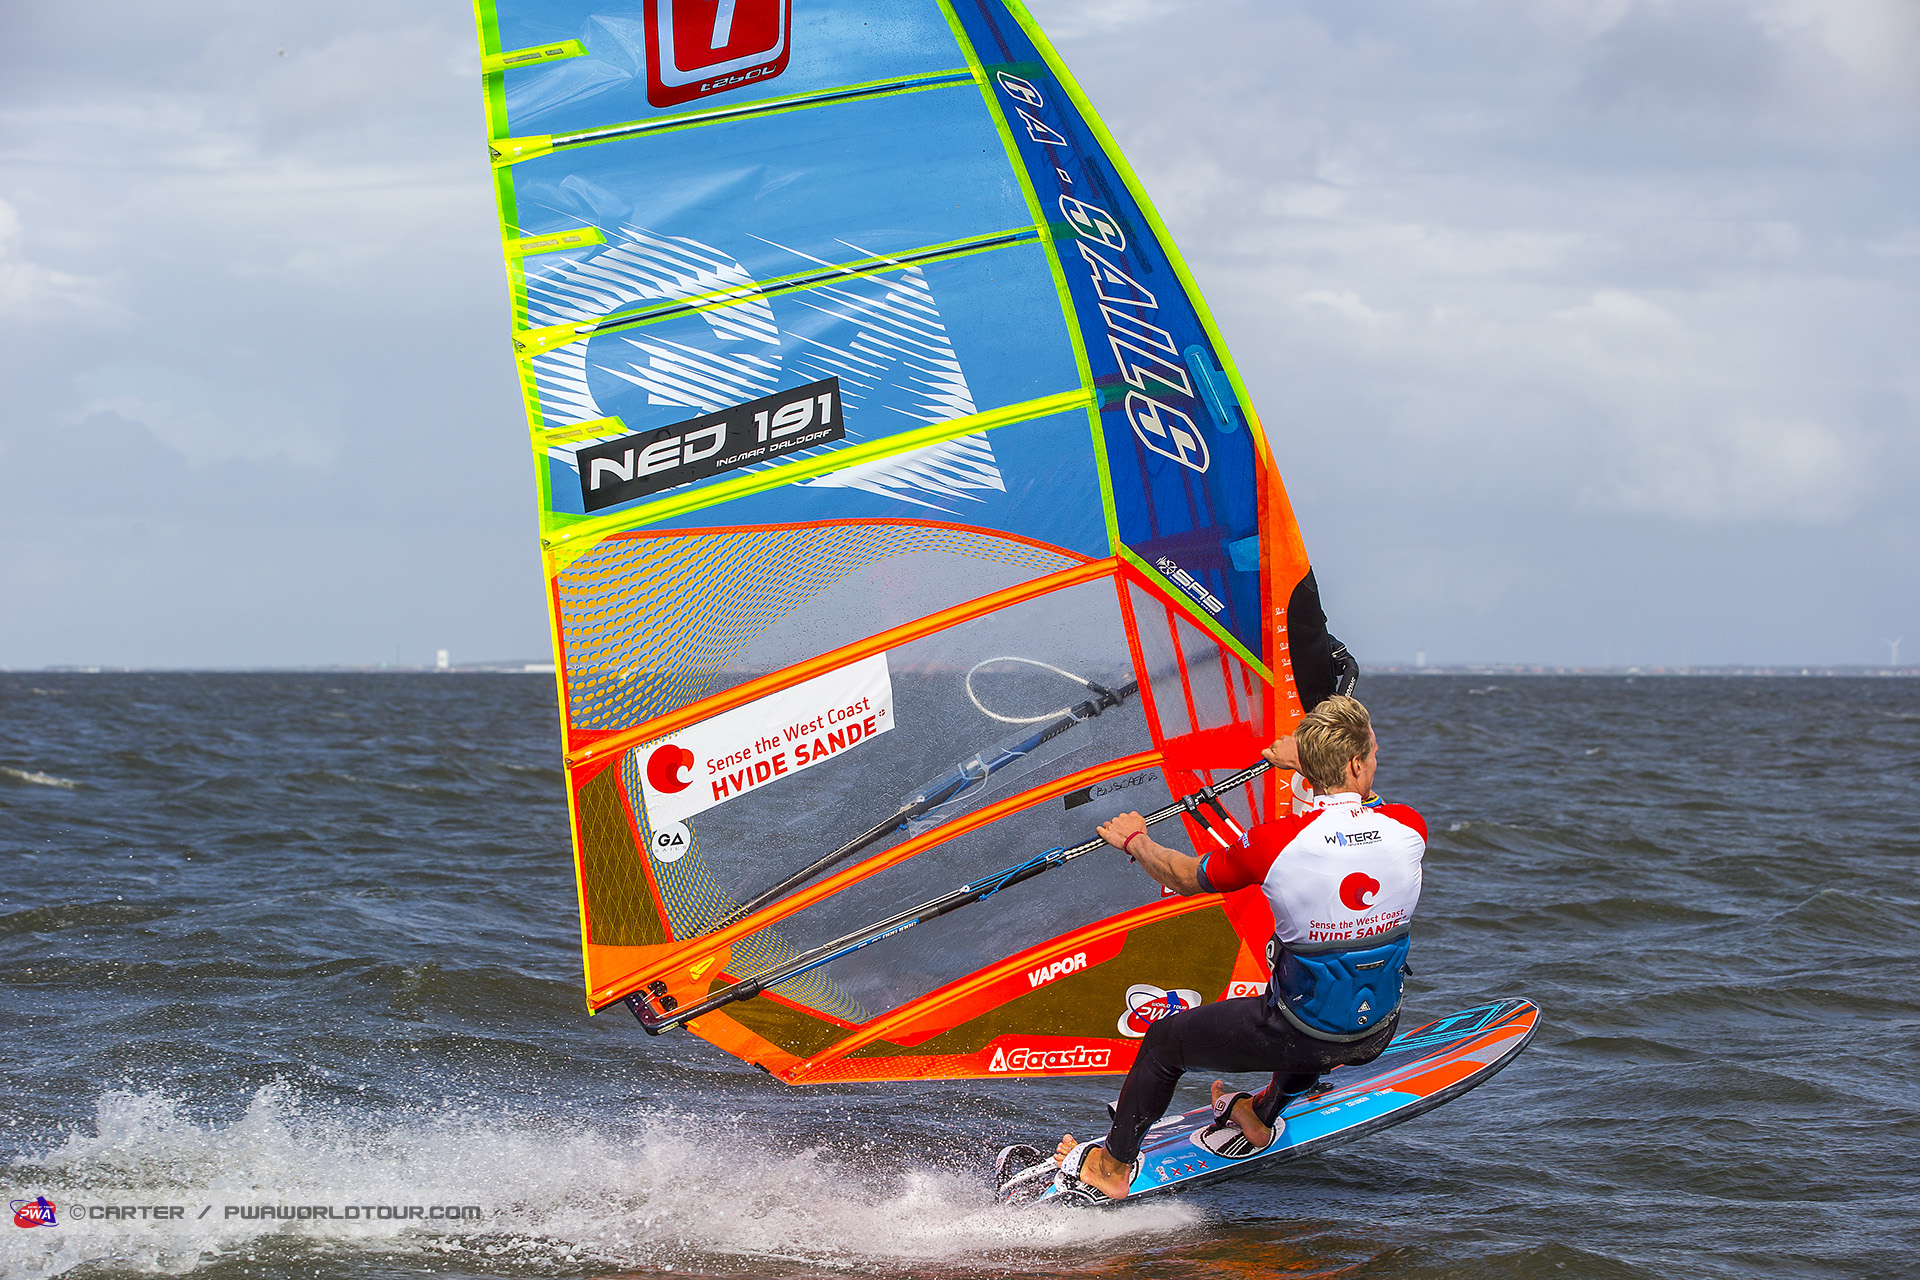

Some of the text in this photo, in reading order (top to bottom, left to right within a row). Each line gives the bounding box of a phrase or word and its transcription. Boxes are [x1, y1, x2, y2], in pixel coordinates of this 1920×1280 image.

[1058, 194, 1210, 474] SAILS
[589, 392, 833, 491] NED 191
[716, 428, 832, 468] INGMAR DALDORF
[706, 696, 871, 775] Sense the West Coast
[711, 714, 877, 802] HVIDE SANDE
[657, 832, 684, 847] GA
[1310, 908, 1404, 930] Sense the West Coast
[1356, 917, 1402, 939] SANDE
[1028, 952, 1088, 988] VAPOR
[1233, 983, 1259, 997] GA
[1006, 1046, 1111, 1071] Gaastra
